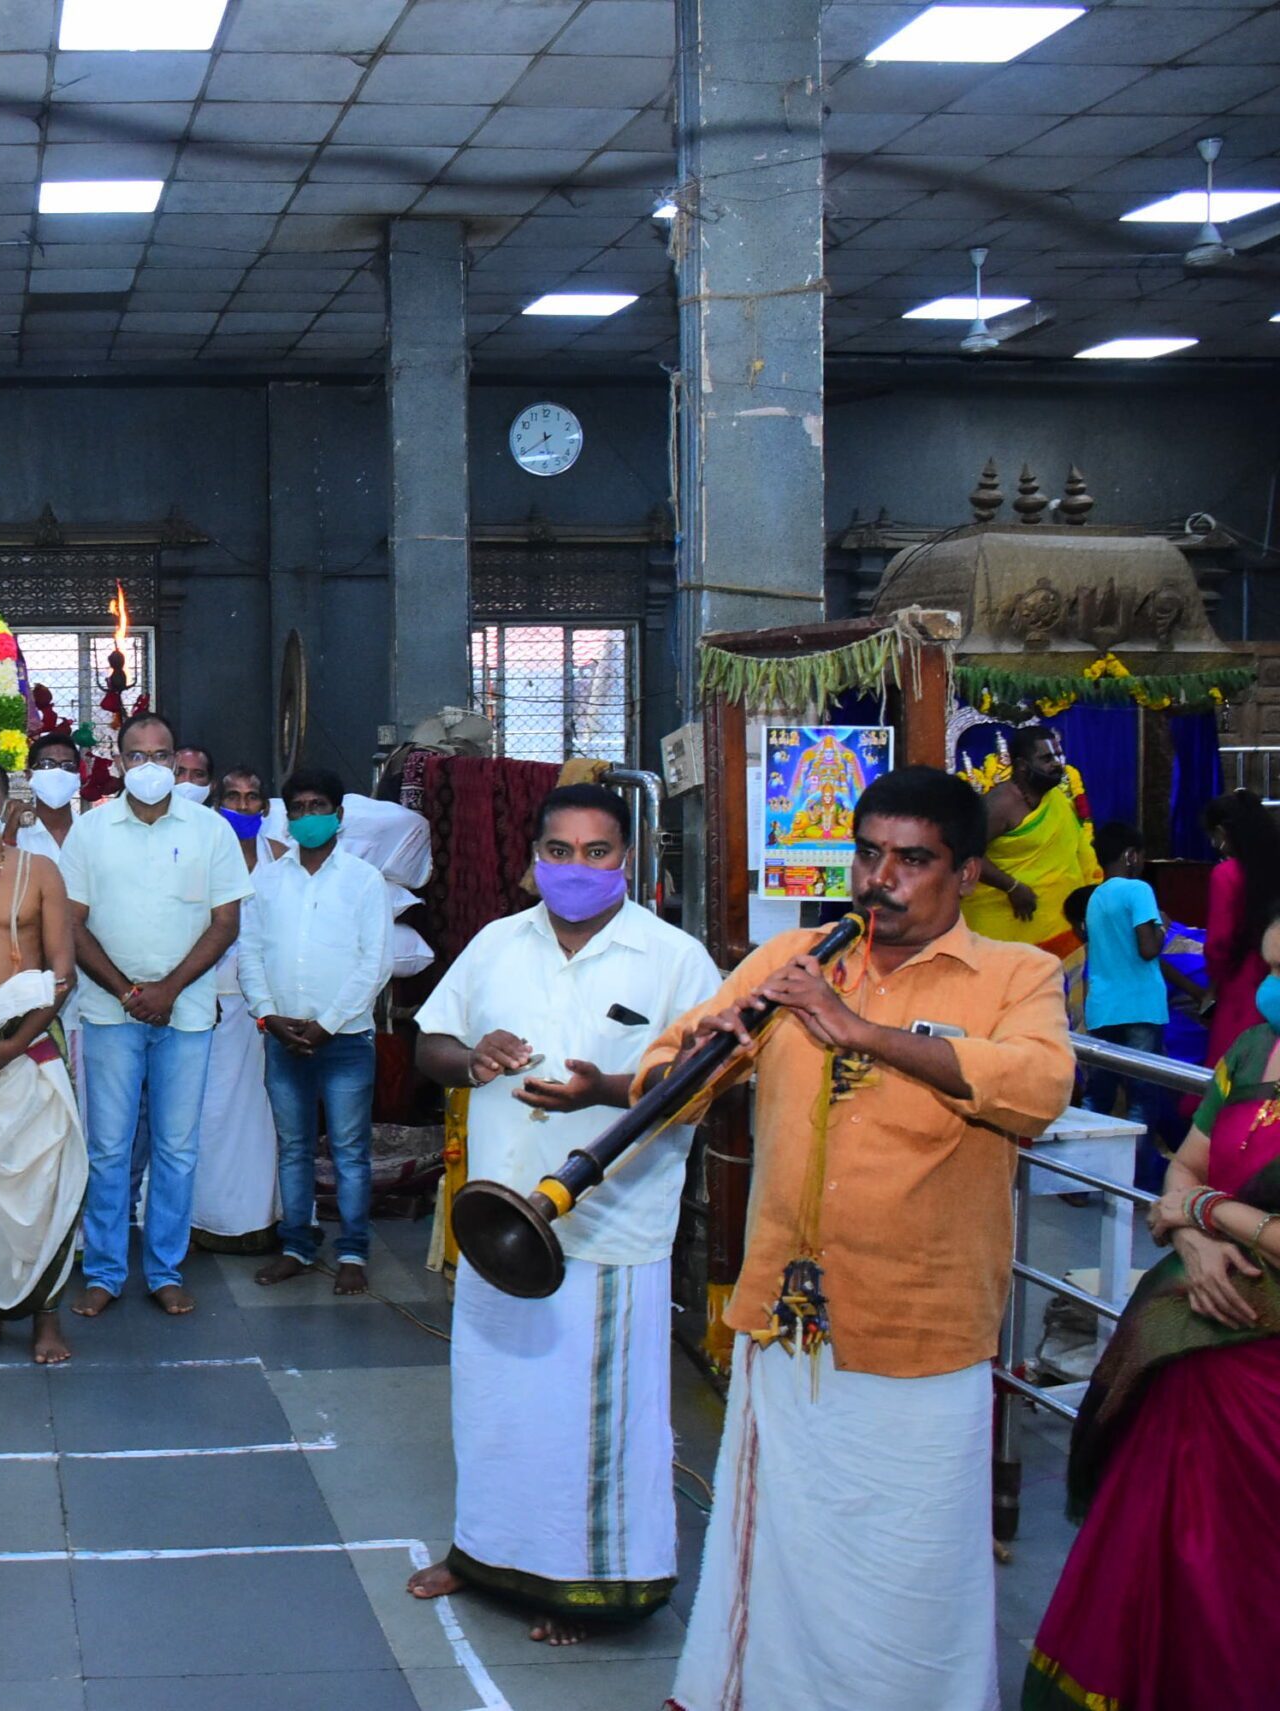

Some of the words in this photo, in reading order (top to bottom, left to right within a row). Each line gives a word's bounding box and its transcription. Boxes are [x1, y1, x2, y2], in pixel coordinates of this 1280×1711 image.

[542, 407, 551, 418] 12
[530, 413, 538, 422] 11
[521, 421, 531, 430] 10
[565, 422, 572, 432] 2
